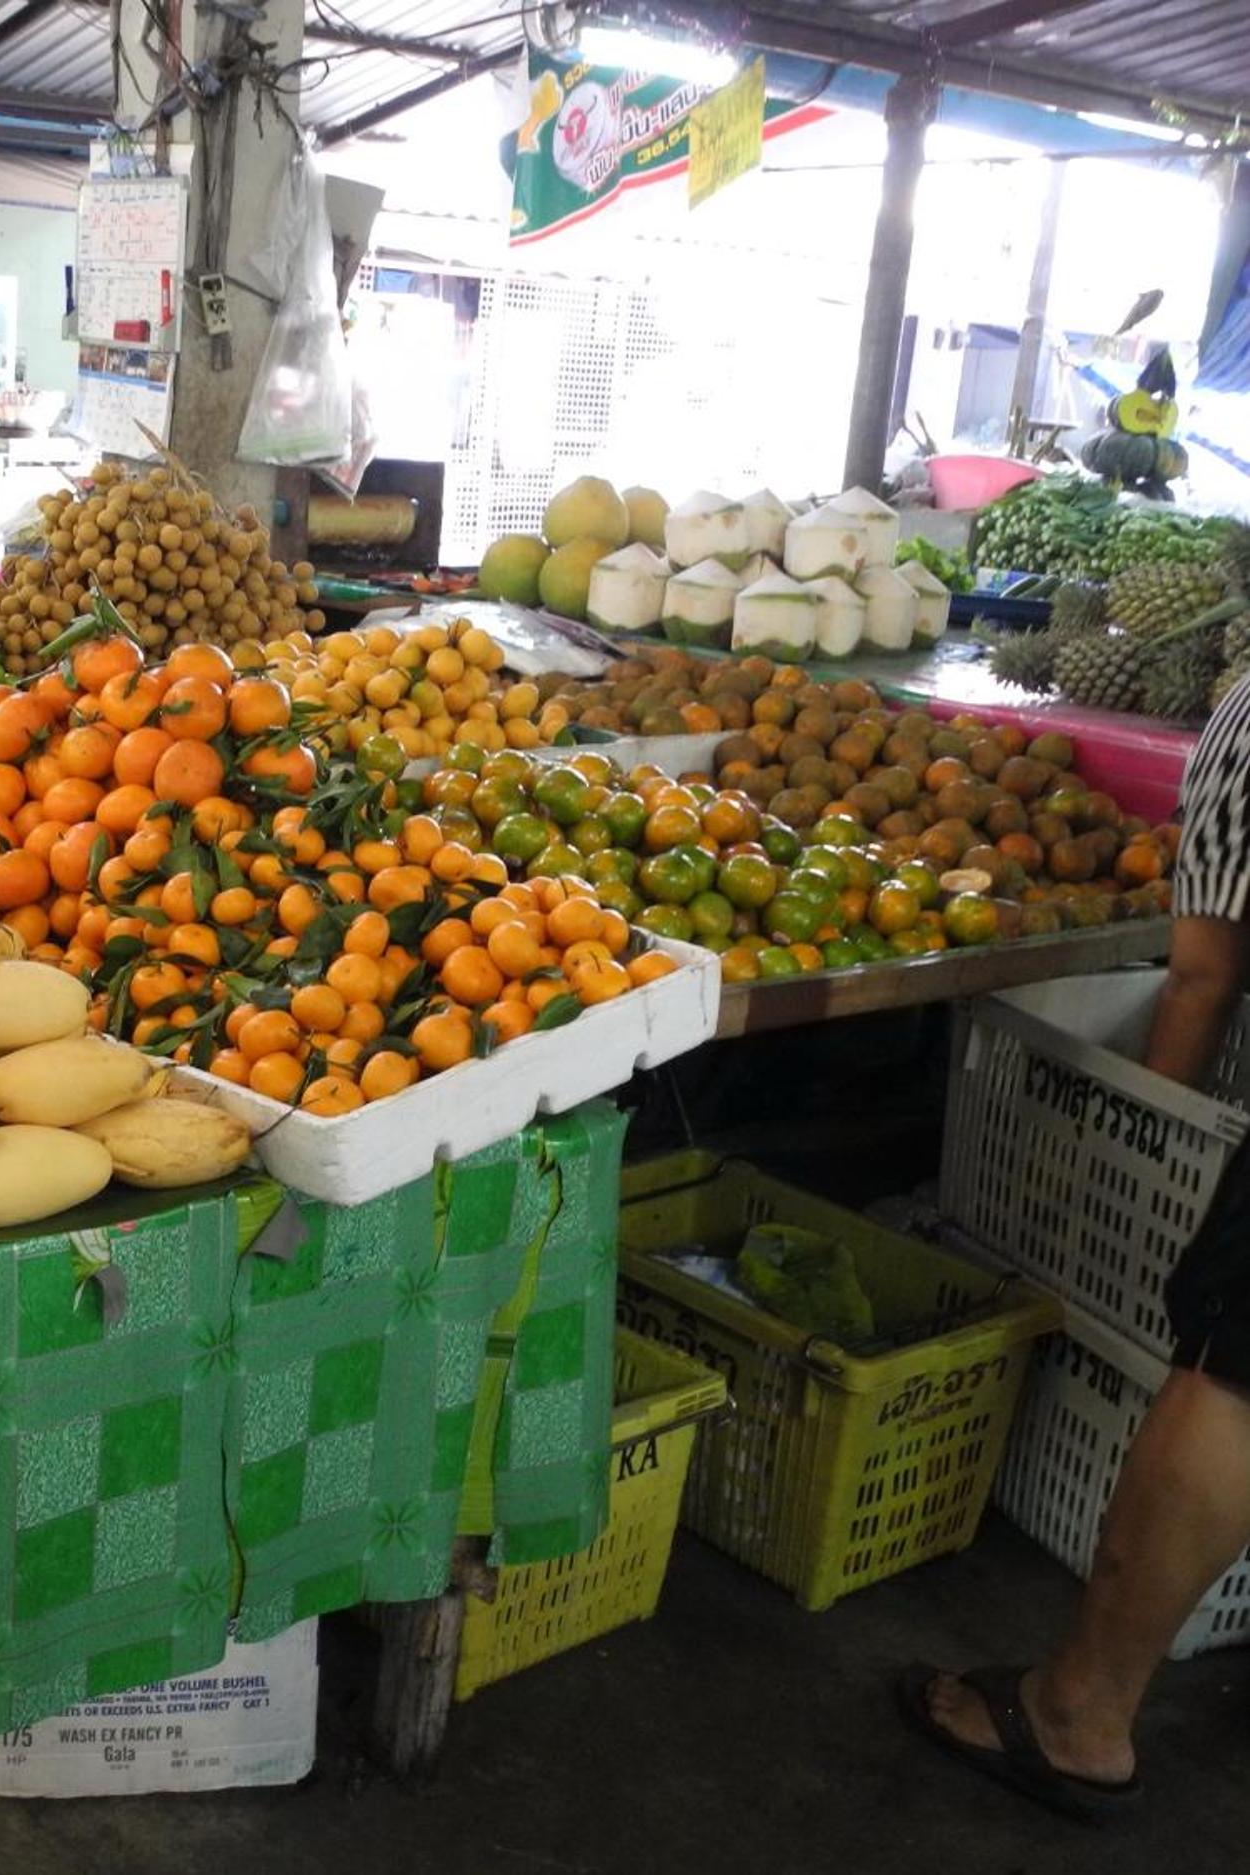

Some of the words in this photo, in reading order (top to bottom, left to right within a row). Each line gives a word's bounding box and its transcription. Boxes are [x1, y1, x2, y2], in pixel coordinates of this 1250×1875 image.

[140, 1681, 165, 1694] ONE
[169, 1678, 218, 1692] VOLUME
[222, 1675, 266, 1689] BUSHEL
[84, 1705, 99, 1717] OR
[101, 1703, 143, 1717] EXCEEDS
[166, 1701, 196, 1714] EXTRA
[199, 1700, 231, 1713] FANCY
[242, 1698, 262, 1710] CAT
[58, 1728, 96, 1744] WASH
[101, 1728, 116, 1742] EX
[121, 1726, 161, 1741] FANCY
[166, 1725, 183, 1740] PR
[104, 1746, 136, 1762] Gala
